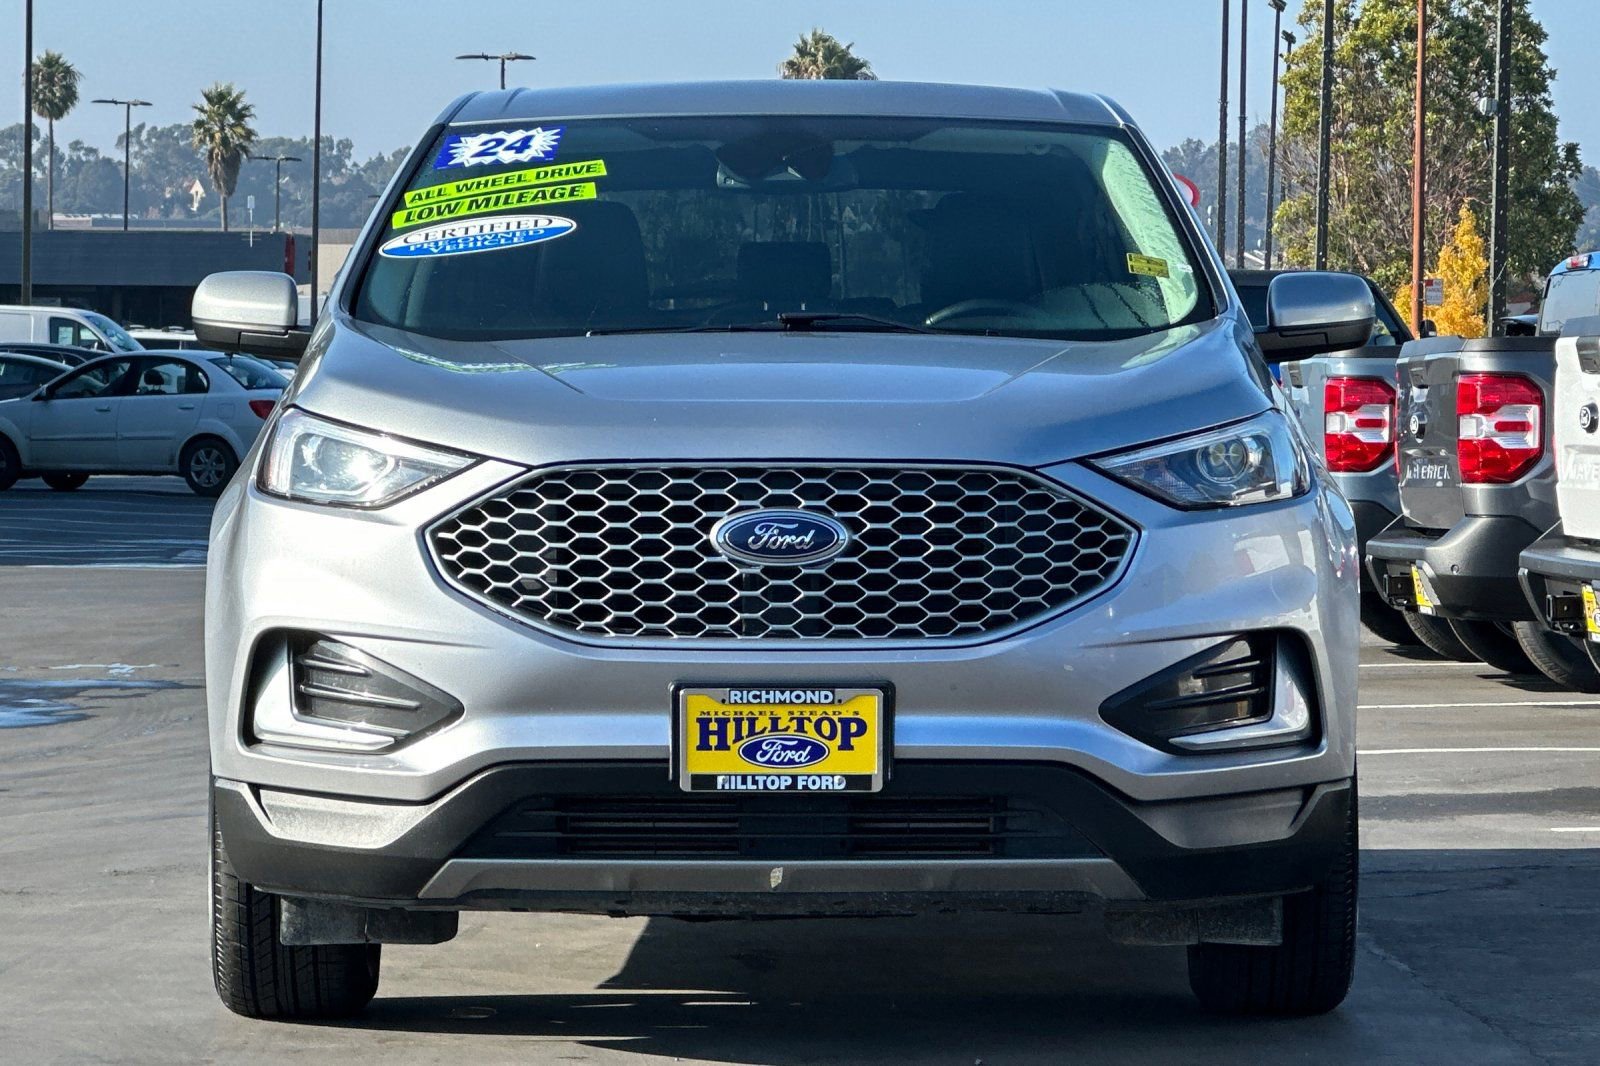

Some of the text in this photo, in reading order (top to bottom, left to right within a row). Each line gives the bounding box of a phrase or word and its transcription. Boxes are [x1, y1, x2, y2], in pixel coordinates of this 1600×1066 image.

[470, 134, 536, 158] 24
[409, 163, 598, 203] ALL WHEEL DRIVE
[403, 184, 583, 223] LOW MILEAGE
[403, 217, 553, 244] CERTIFIED
[429, 236, 525, 253] VEHICLE
[748, 522, 816, 549] Ford
[729, 690, 834, 704] RICHMOND
[696, 716, 868, 752] HILLTOP
[755, 739, 812, 763] Ford
[716, 775, 847, 790] HILLTOP FORD
